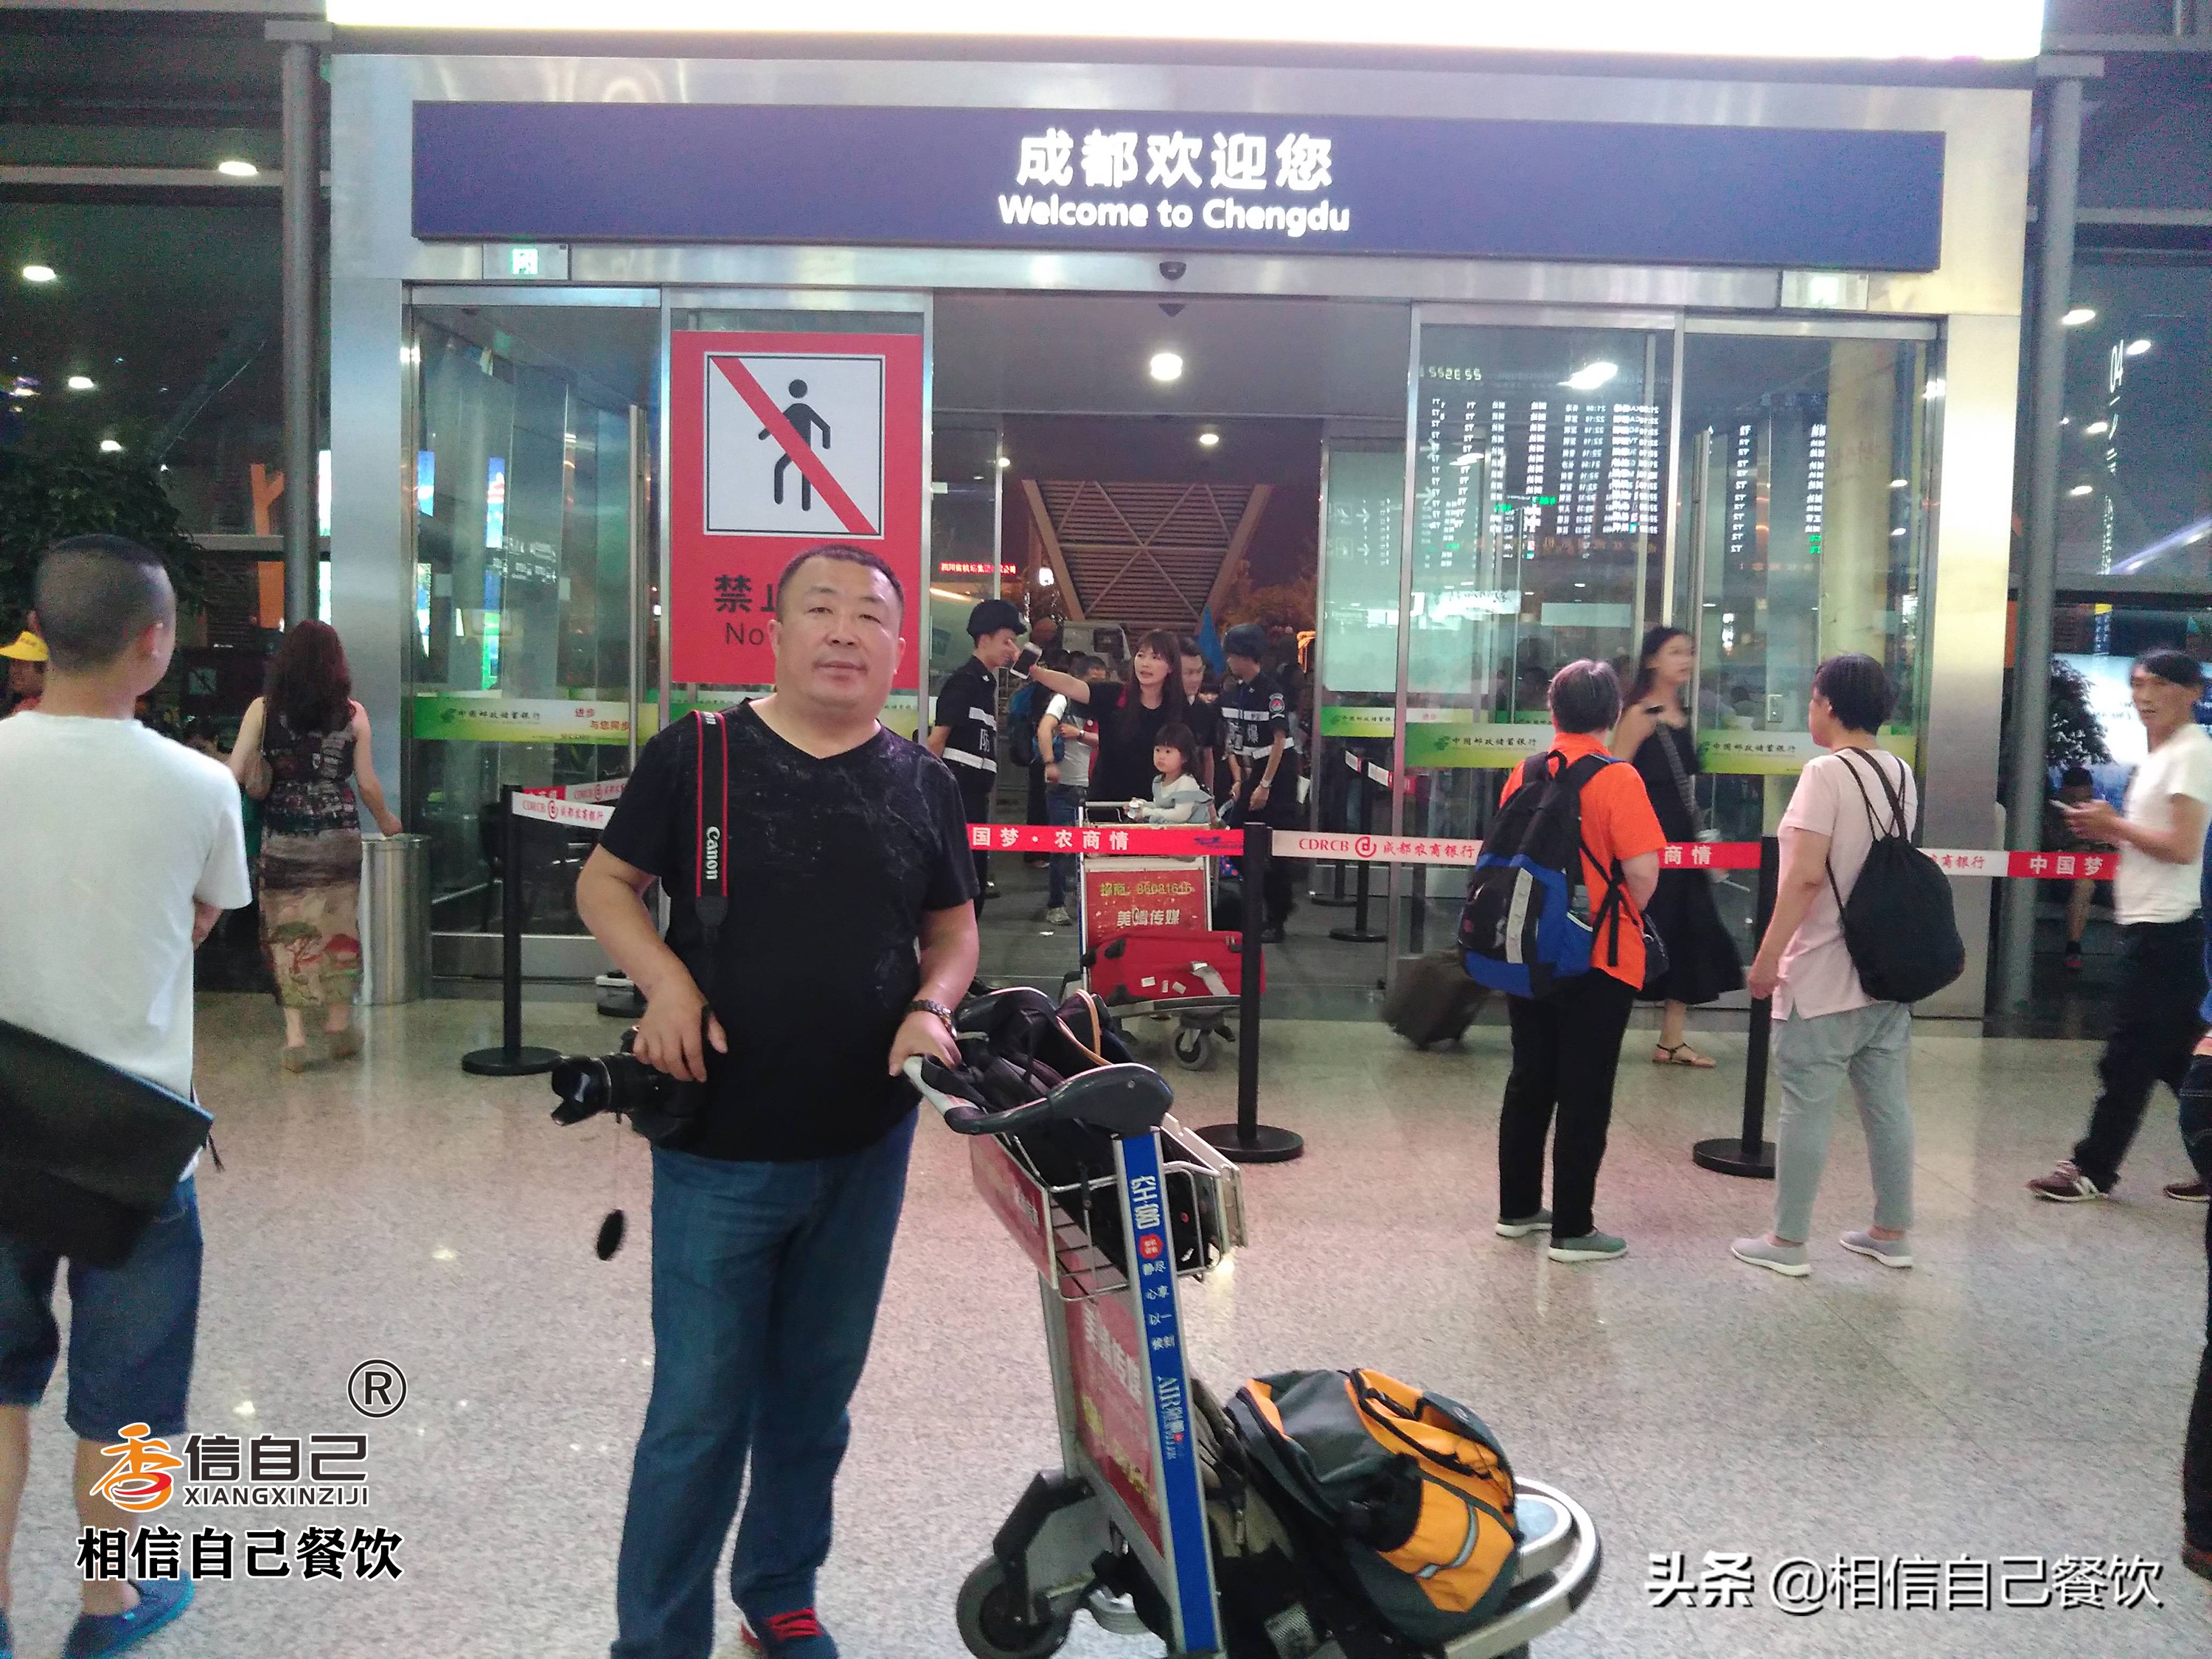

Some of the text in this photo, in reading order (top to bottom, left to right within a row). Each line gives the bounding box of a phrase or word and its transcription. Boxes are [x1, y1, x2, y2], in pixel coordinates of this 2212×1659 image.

[1016, 128, 1332, 191] 成都欢迎您
[998, 195, 1350, 238] Welcome to Chengdu
[726, 622, 764, 646] No
[1452, 737, 1537, 747] 中国邮政储蓄银行
[1713, 741, 1796, 753] 中国邮政储蓄银行
[706, 826, 721, 880] Canon
[1298, 838, 1475, 859] CDRCB 成都农商银行
[1664, 845, 1711, 866] 商情
[2029, 854, 2104, 876] 中国梦
